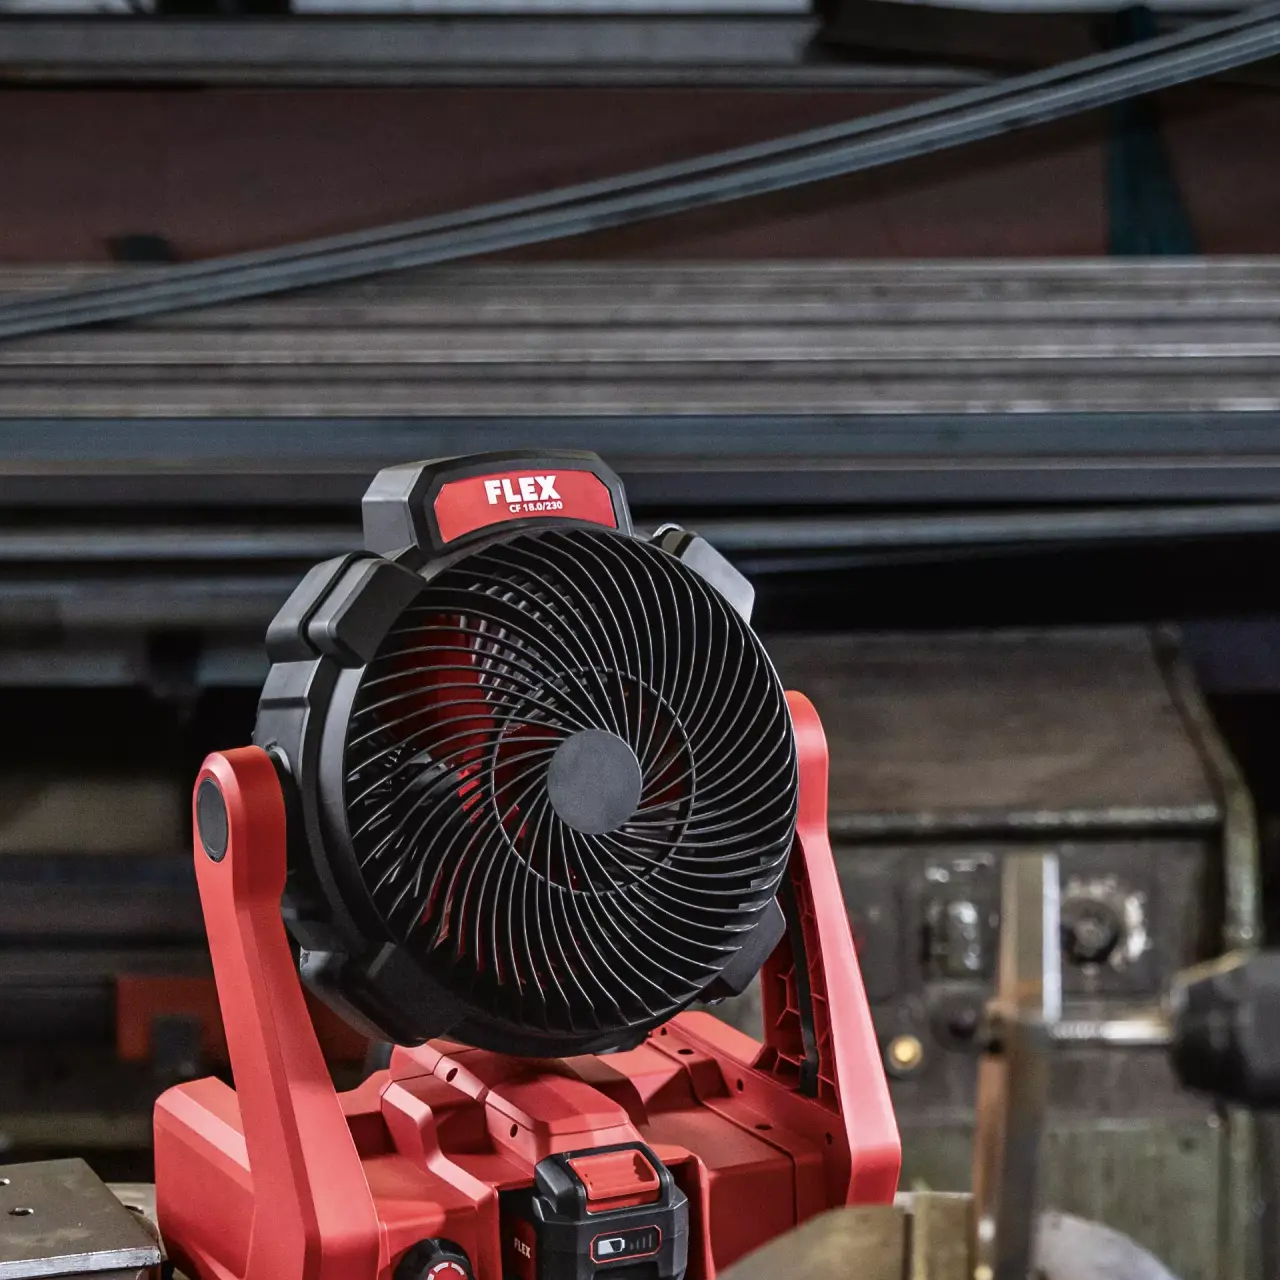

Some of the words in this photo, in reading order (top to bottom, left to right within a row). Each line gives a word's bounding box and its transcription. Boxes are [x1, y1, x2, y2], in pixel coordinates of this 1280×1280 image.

[484, 475, 561, 505] FLEX
[509, 504, 521, 513] CF
[522, 501, 563, 512] 18.0/230
[513, 1236, 531, 1259] FLEX
